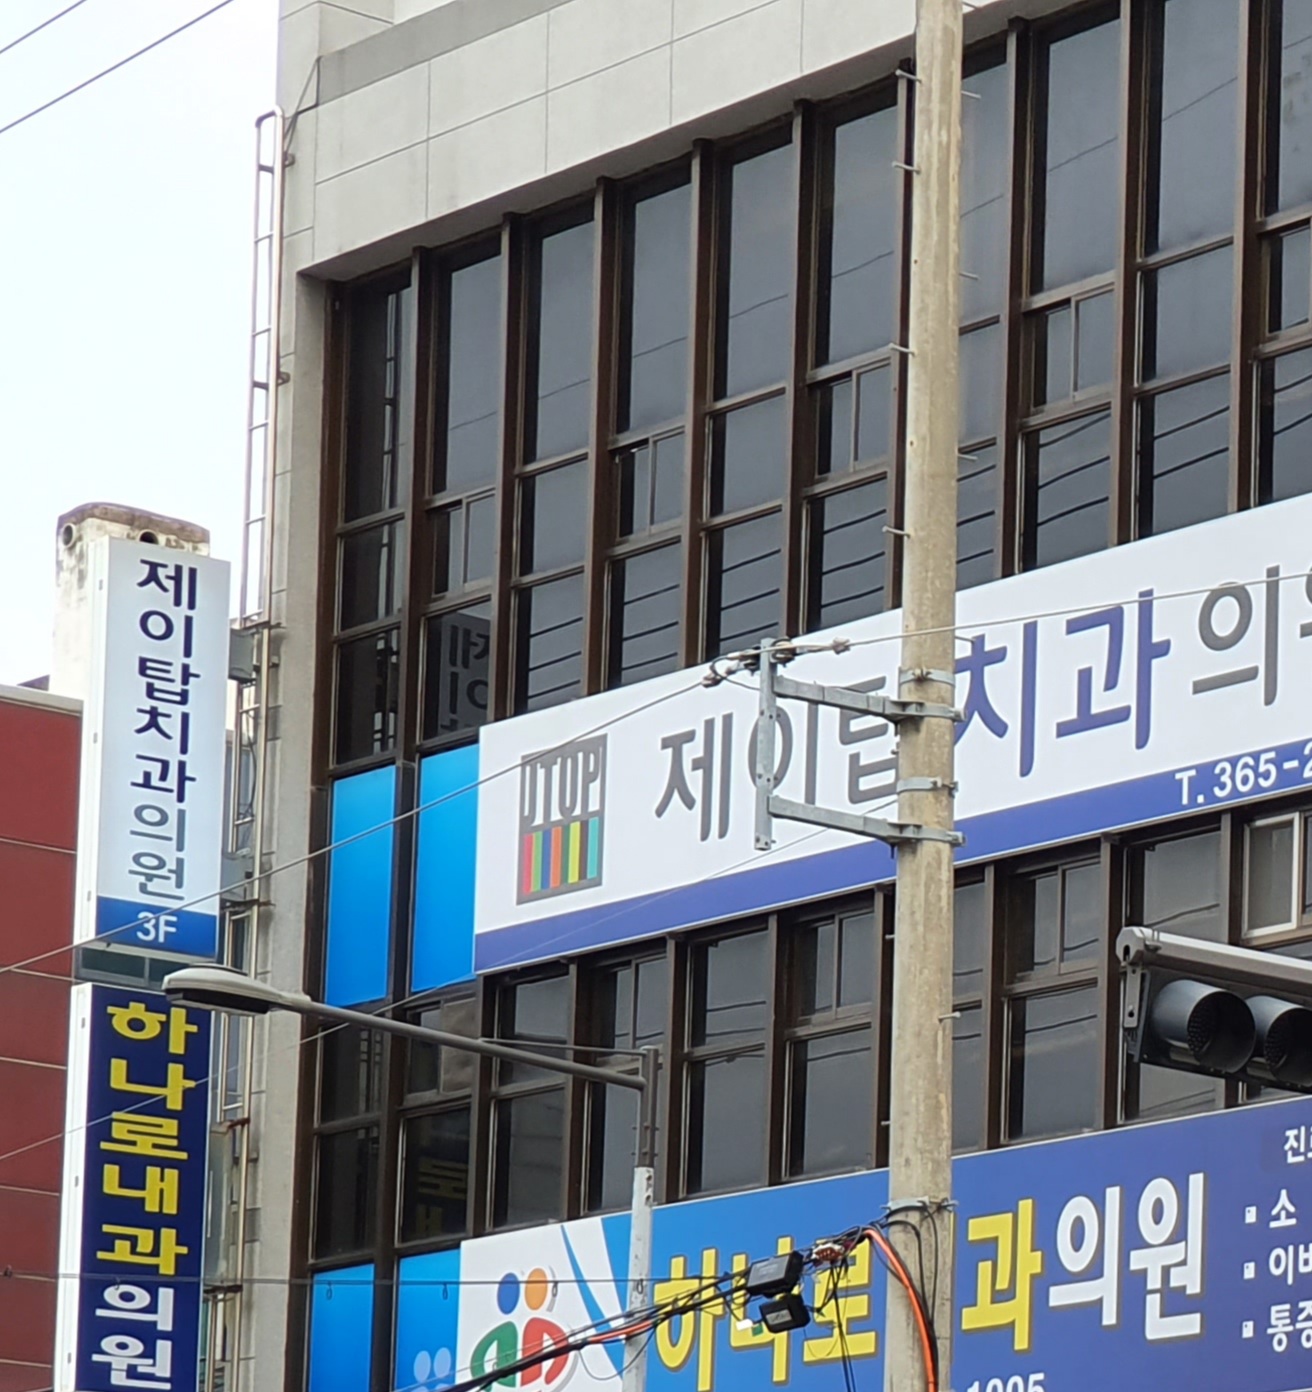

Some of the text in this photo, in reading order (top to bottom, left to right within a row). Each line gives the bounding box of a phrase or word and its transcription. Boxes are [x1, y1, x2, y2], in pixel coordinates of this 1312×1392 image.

[128, 558, 200, 900] 제이탑치과의원
[136, 911, 177, 943] 3F
[92, 1002, 198, 1390] 하나로내과의원
